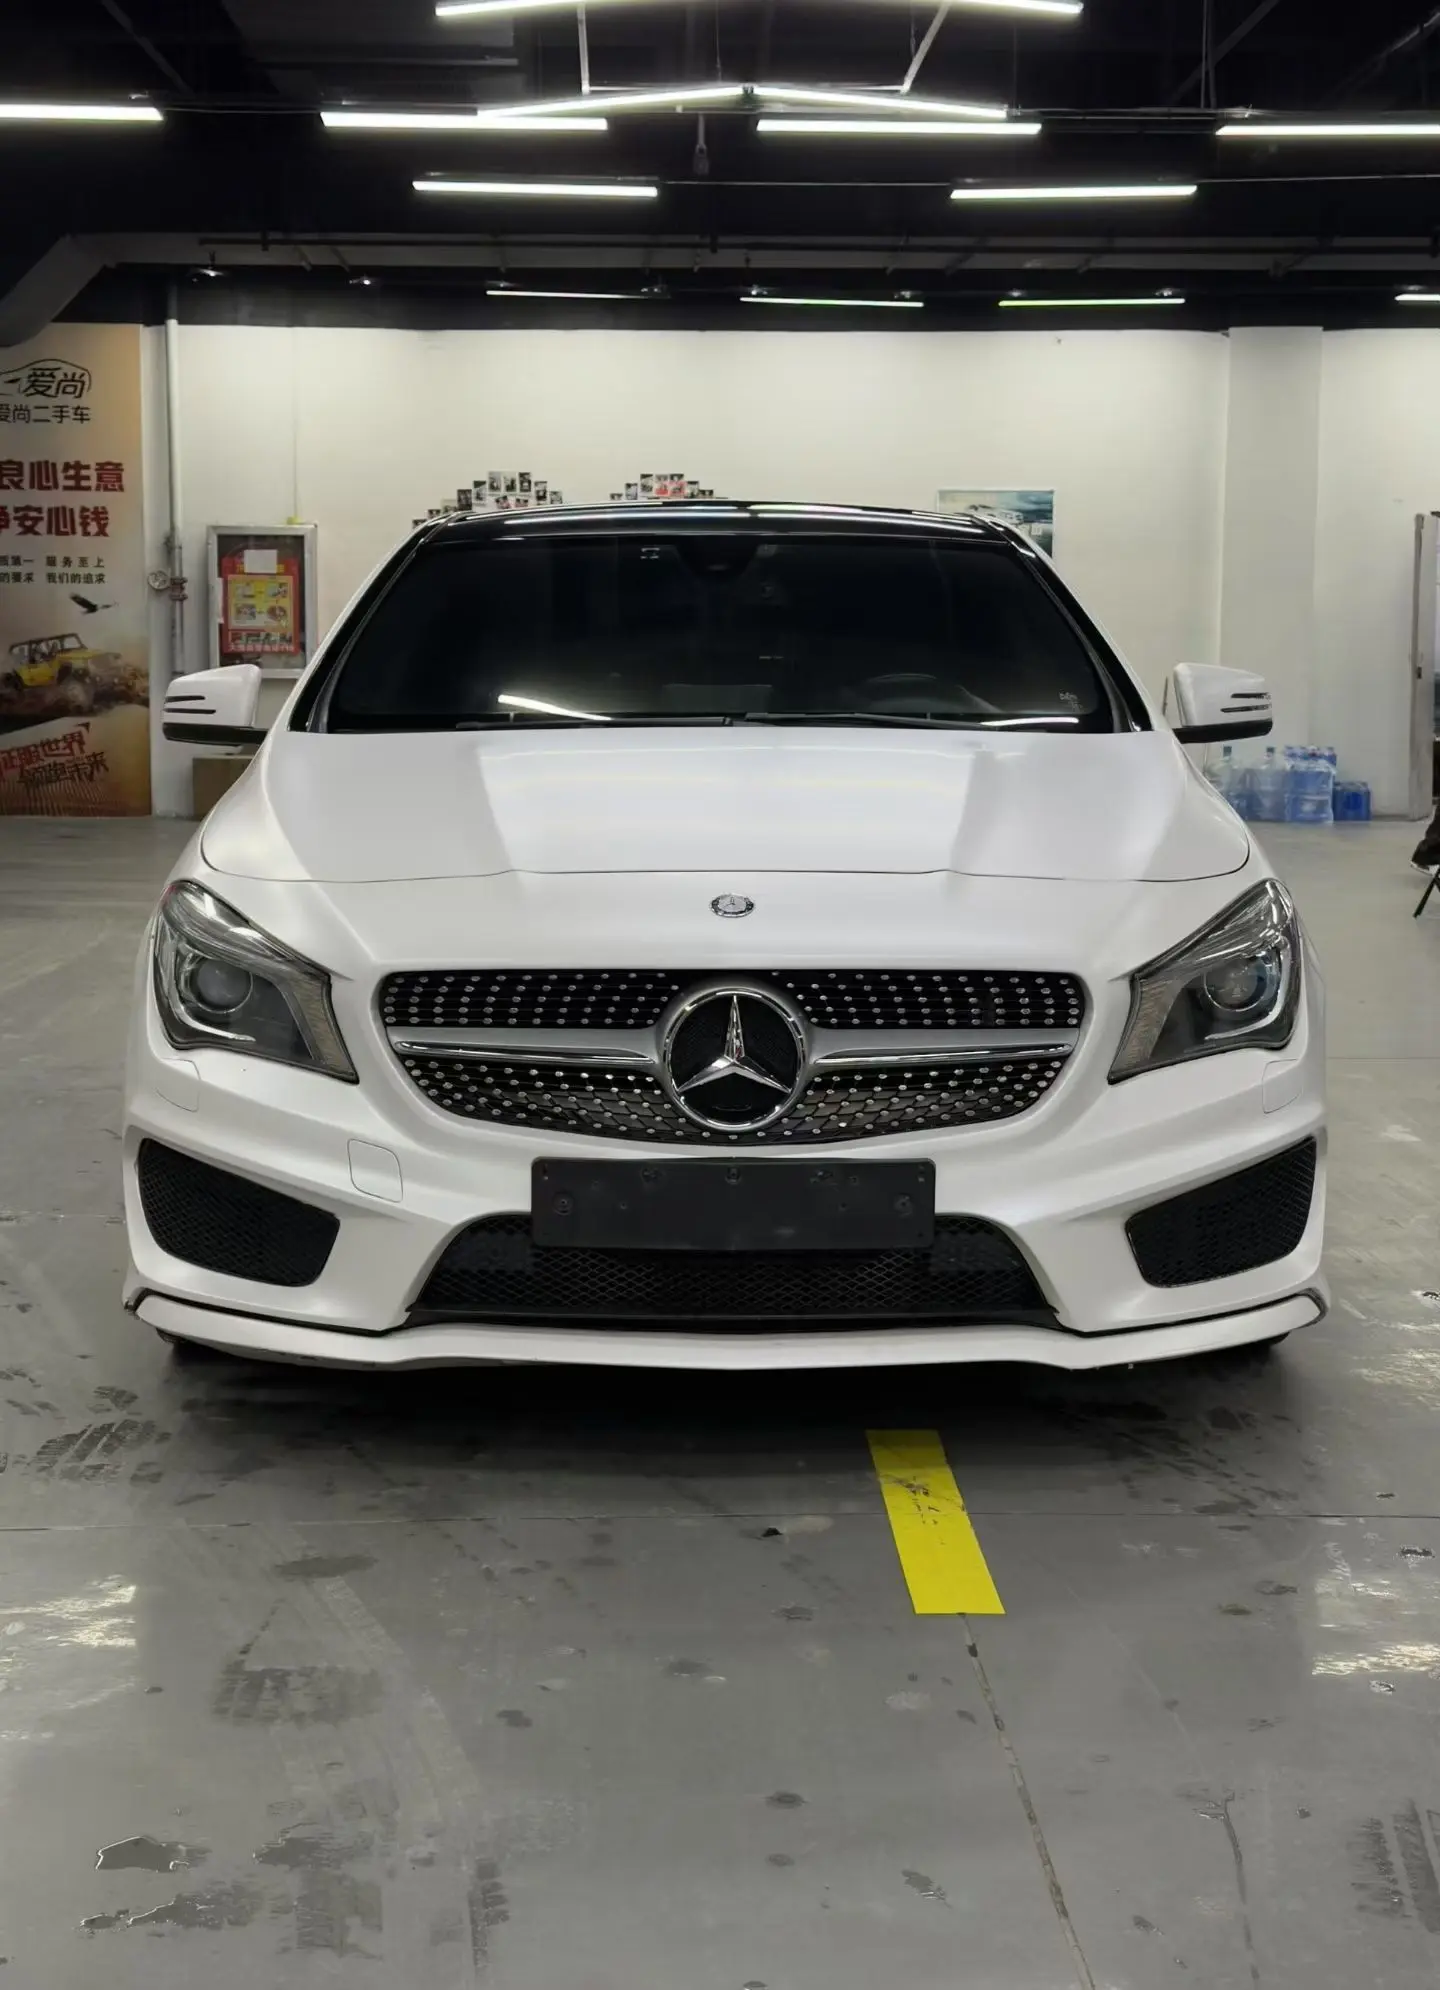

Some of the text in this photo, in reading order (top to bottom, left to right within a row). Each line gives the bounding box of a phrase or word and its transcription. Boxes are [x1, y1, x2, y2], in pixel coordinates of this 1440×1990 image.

[23, 367, 85, 398] 爱尚
[0, 404, 90, 424] 爱尚二手车
[0, 459, 124, 493] 良心生意
